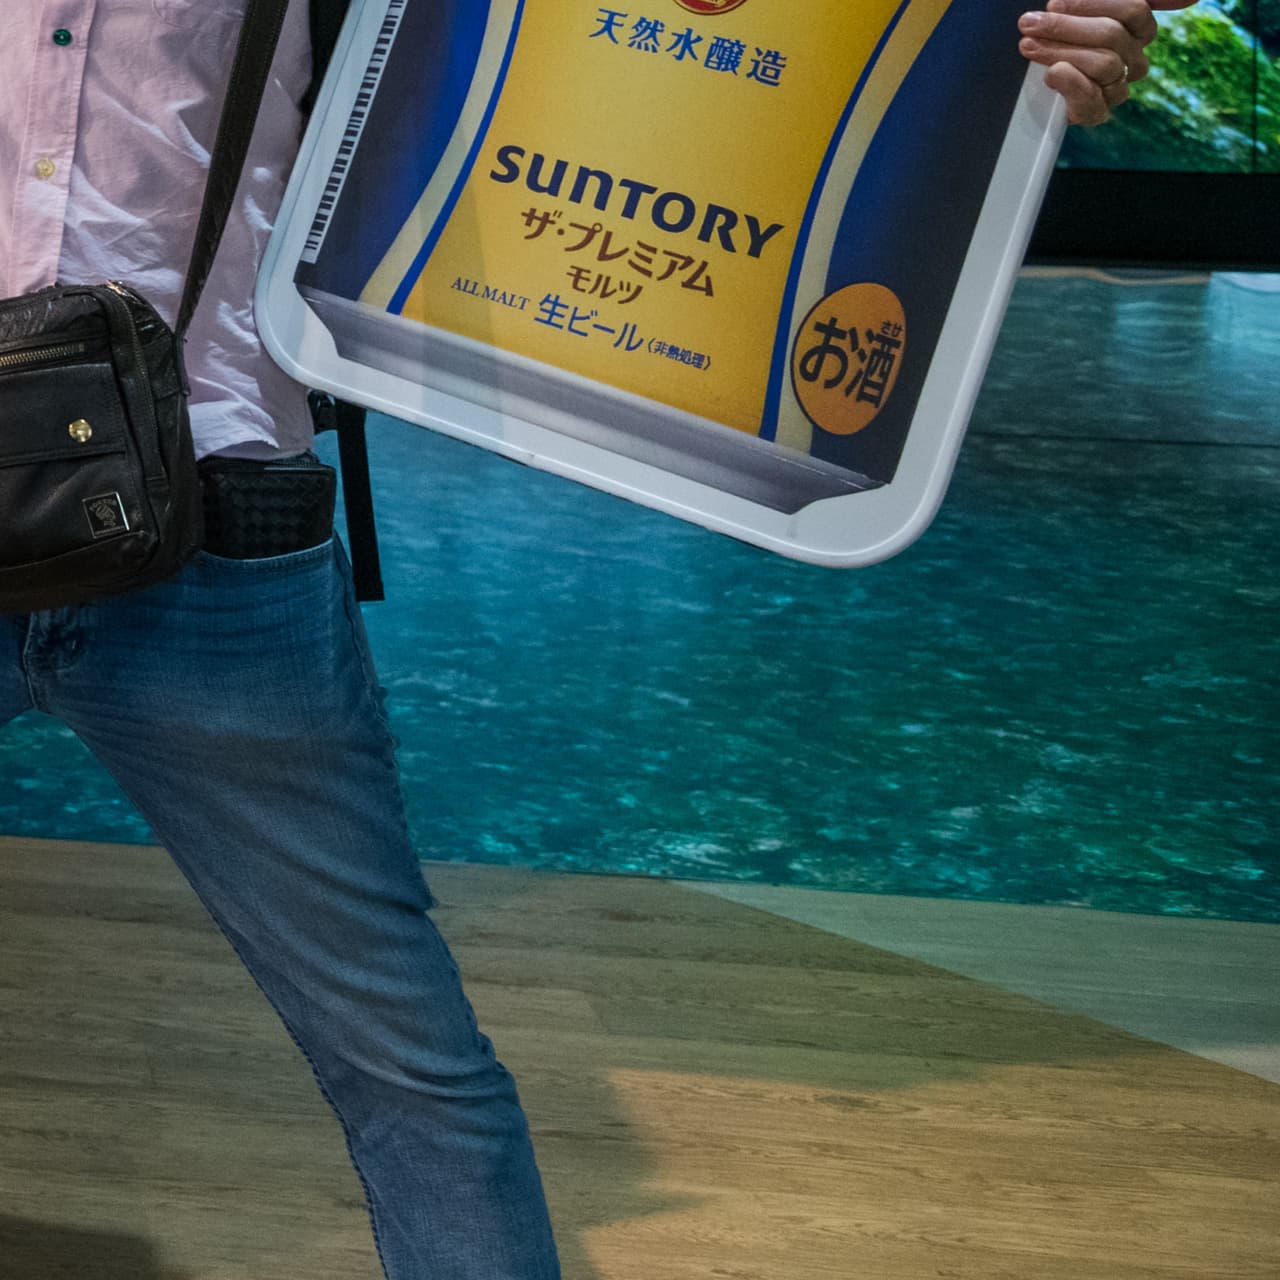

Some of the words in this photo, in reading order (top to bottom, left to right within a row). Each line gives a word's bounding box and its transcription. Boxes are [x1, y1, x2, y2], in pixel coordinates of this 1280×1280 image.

[589, 7, 787, 88] 天然水醸造
[489, 144, 785, 259] SUNTORY
[520, 207, 715, 298] ザ・プレミアム
[566, 264, 644, 305] モルツ
[451, 276, 480, 298] ALL
[481, 287, 532, 312] MALT
[880, 319, 904, 338] さけ
[799, 317, 902, 410] お酒
